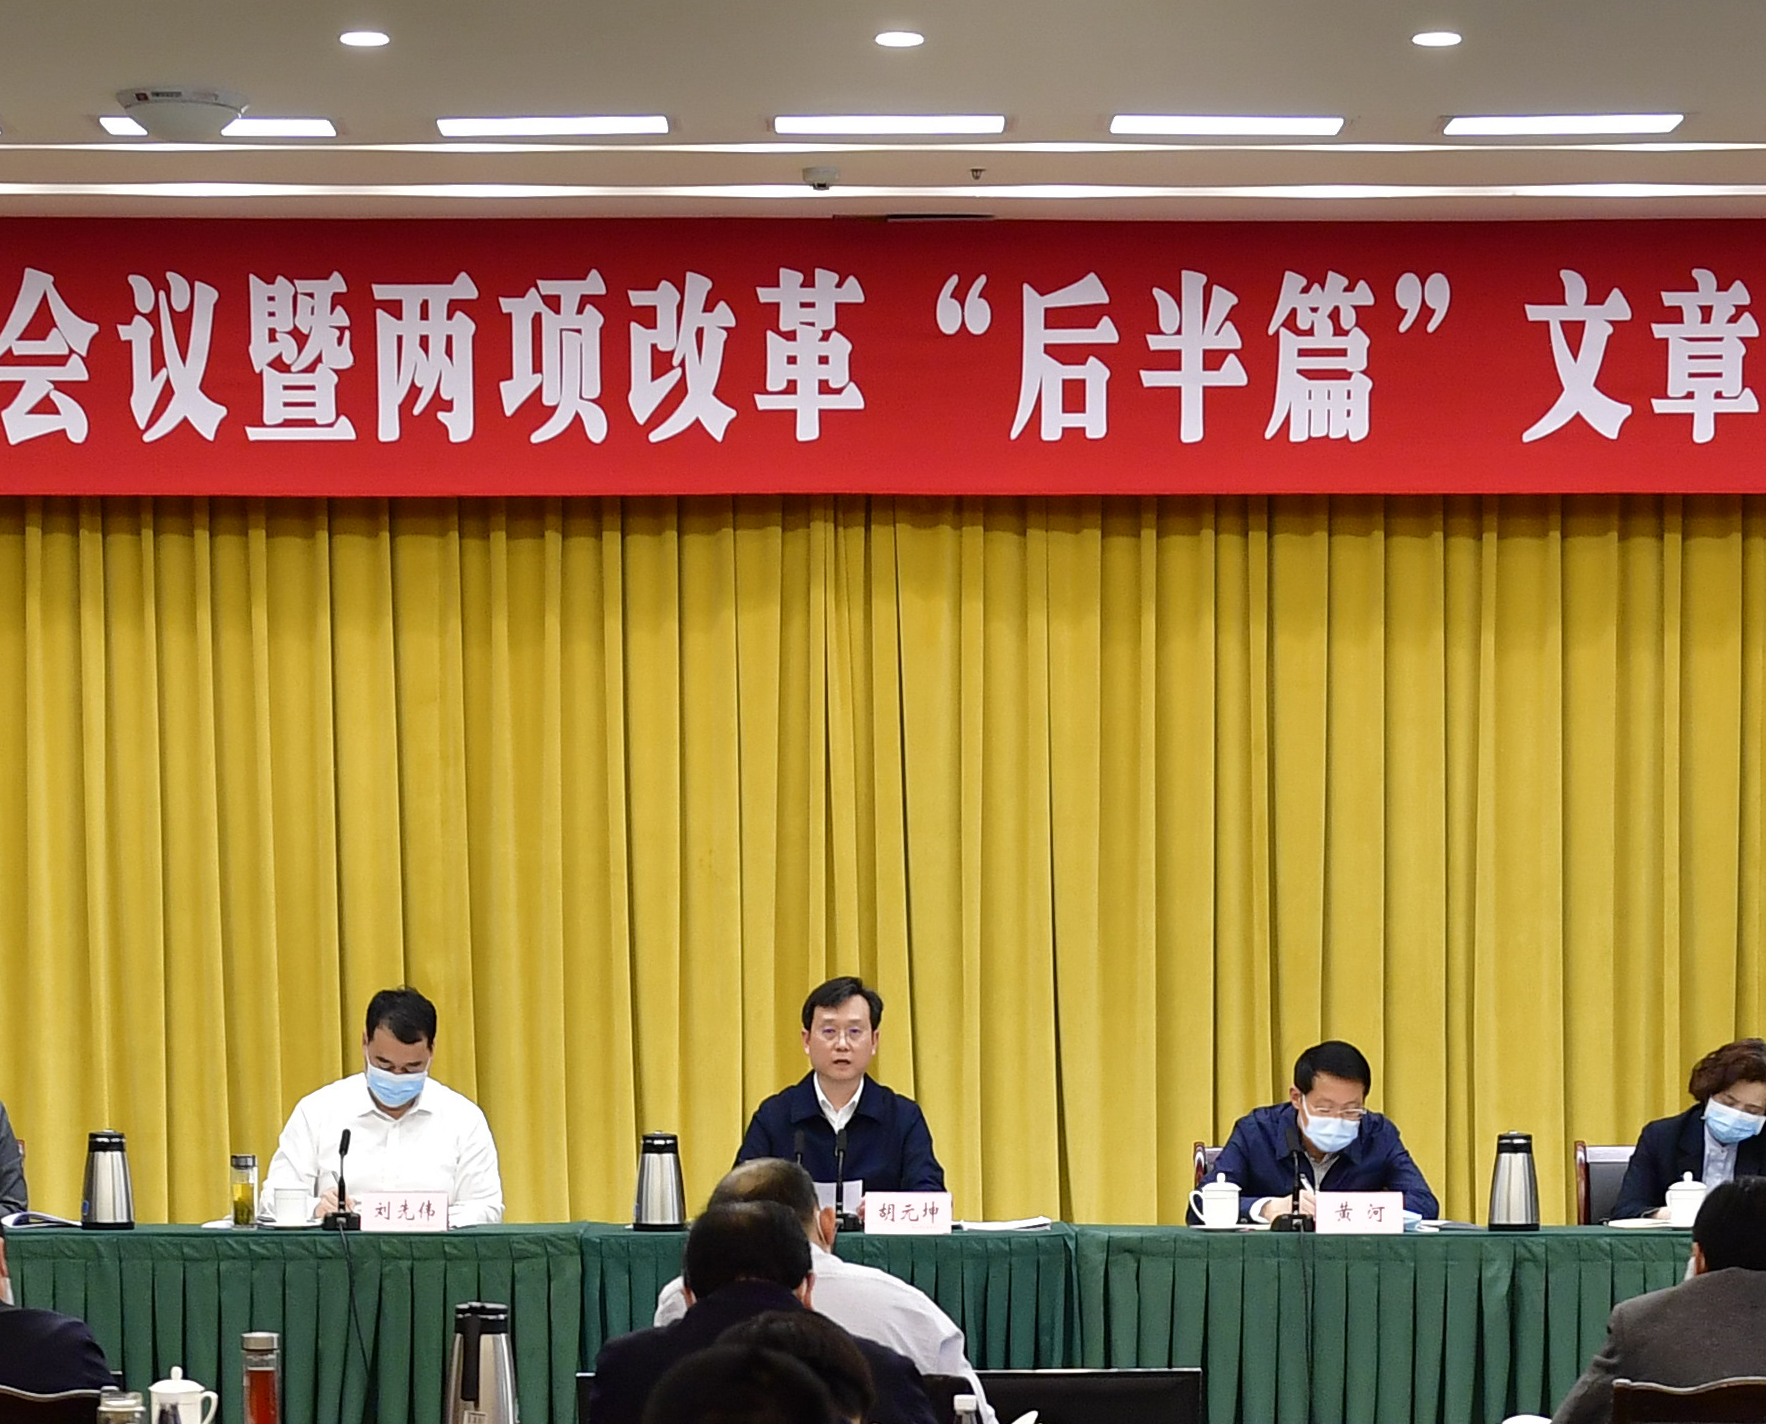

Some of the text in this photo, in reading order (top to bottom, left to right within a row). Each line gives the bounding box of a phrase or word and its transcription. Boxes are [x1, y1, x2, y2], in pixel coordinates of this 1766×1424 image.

[374, 1199, 436, 1222] 刘先伟
[878, 1201, 940, 1224] 胡元坤
[1334, 1201, 1385, 1223] 黄河
